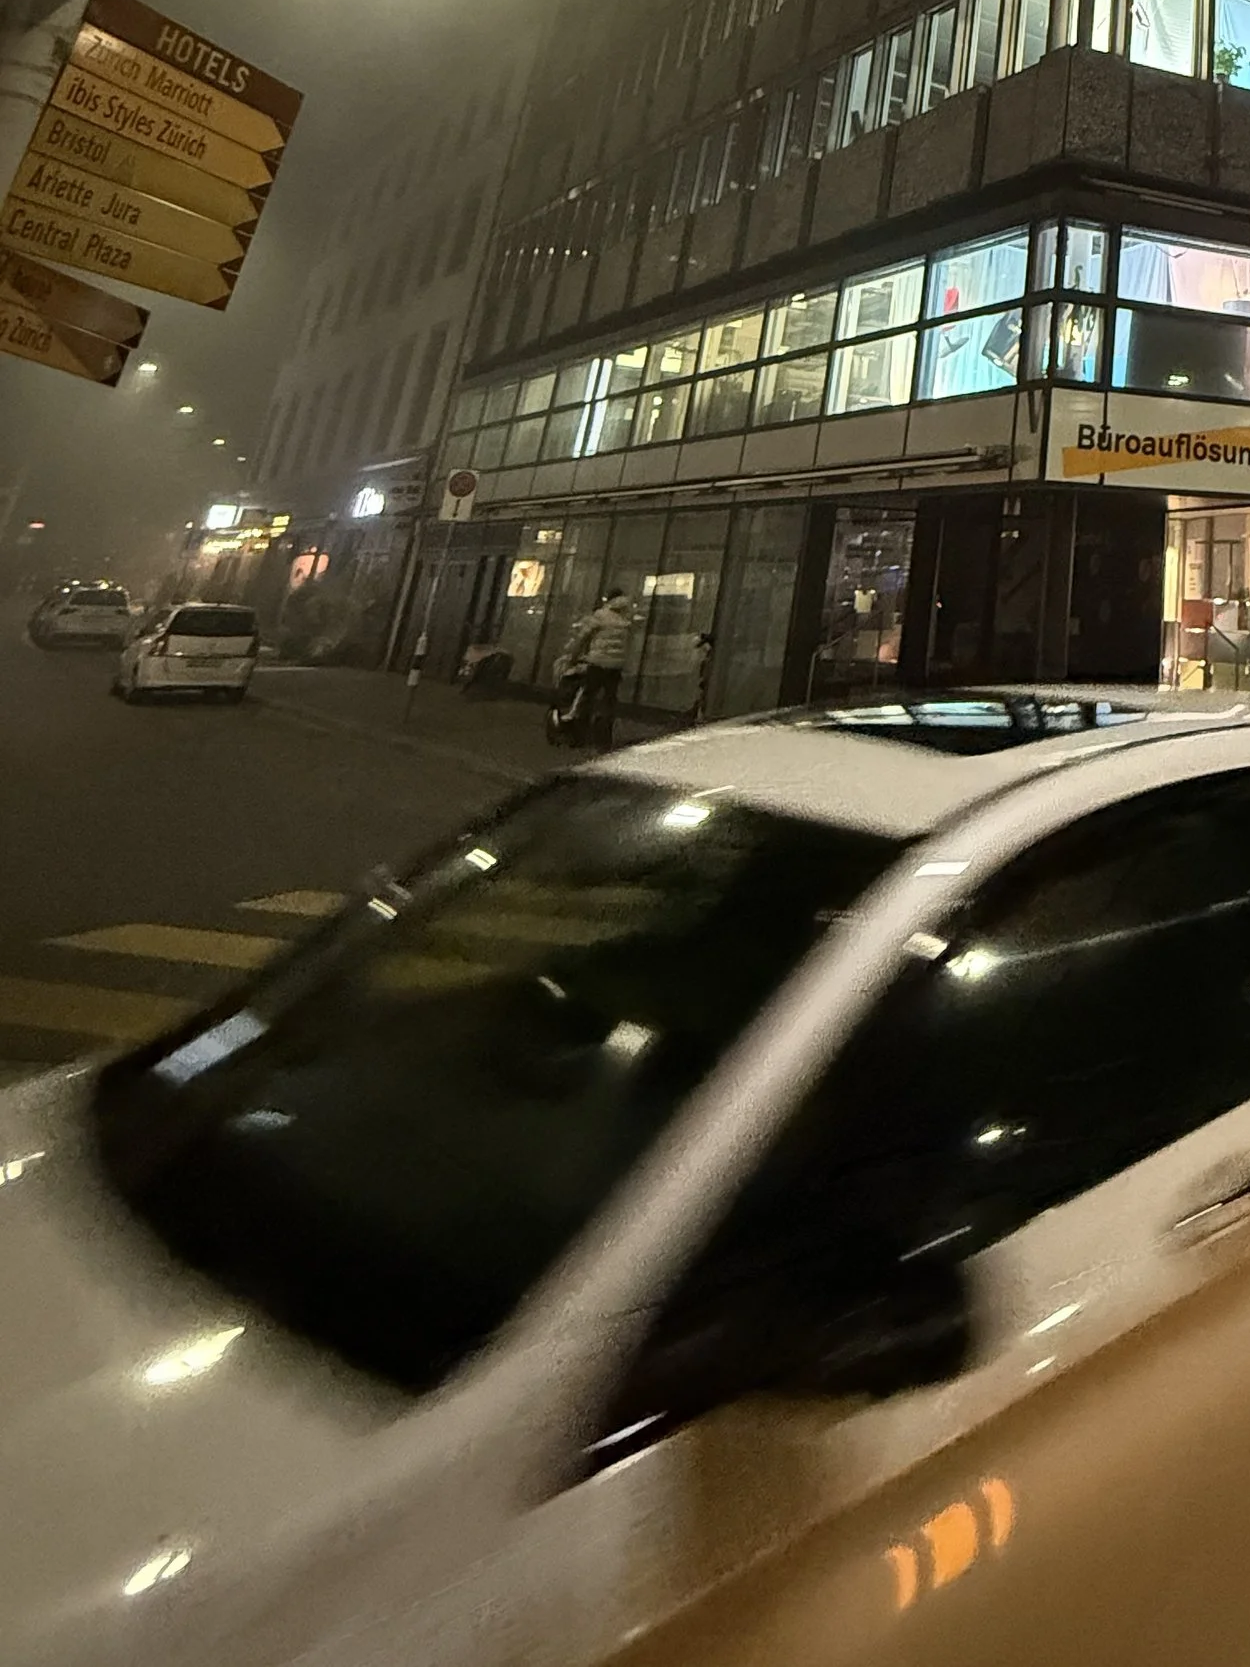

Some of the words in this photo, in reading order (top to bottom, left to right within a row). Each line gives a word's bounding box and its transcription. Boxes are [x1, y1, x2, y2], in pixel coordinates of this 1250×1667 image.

[156, 25, 250, 94] HOTELS
[66, 76, 101, 113] ibis
[103, 95, 156, 136] Styles
[156, 119, 208, 160] Zürich
[145, 66, 214, 116] Marriott
[47, 119, 112, 165] Bristol
[101, 192, 143, 226] Jura
[7, 208, 80, 252] Central
[83, 234, 132, 270] Plaza
